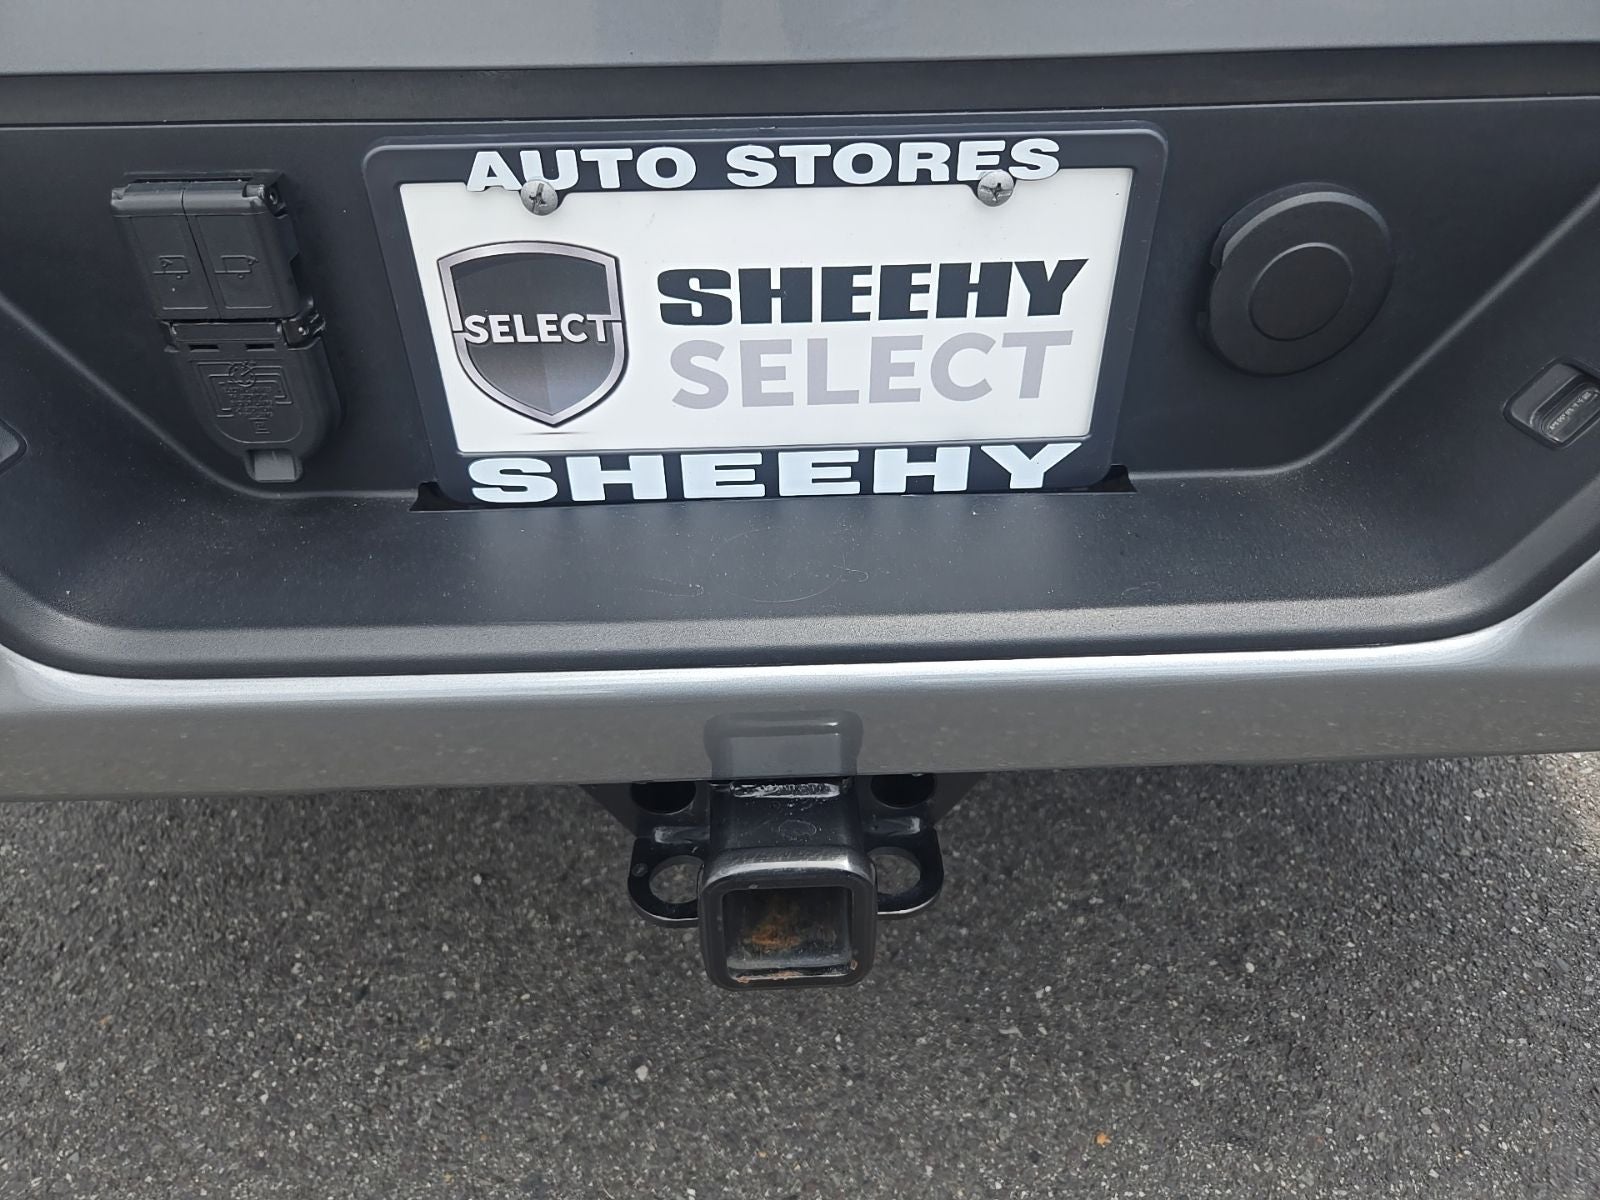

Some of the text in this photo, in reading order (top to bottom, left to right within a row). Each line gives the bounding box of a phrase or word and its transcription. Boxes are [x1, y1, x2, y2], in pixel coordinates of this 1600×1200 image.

[466, 138, 1061, 191] AUTO STORES
[657, 259, 1088, 325] SHEEHY
[463, 313, 608, 343] SELECT
[670, 332, 1073, 410] SELECT
[468, 442, 1082, 504] SHEEHY
